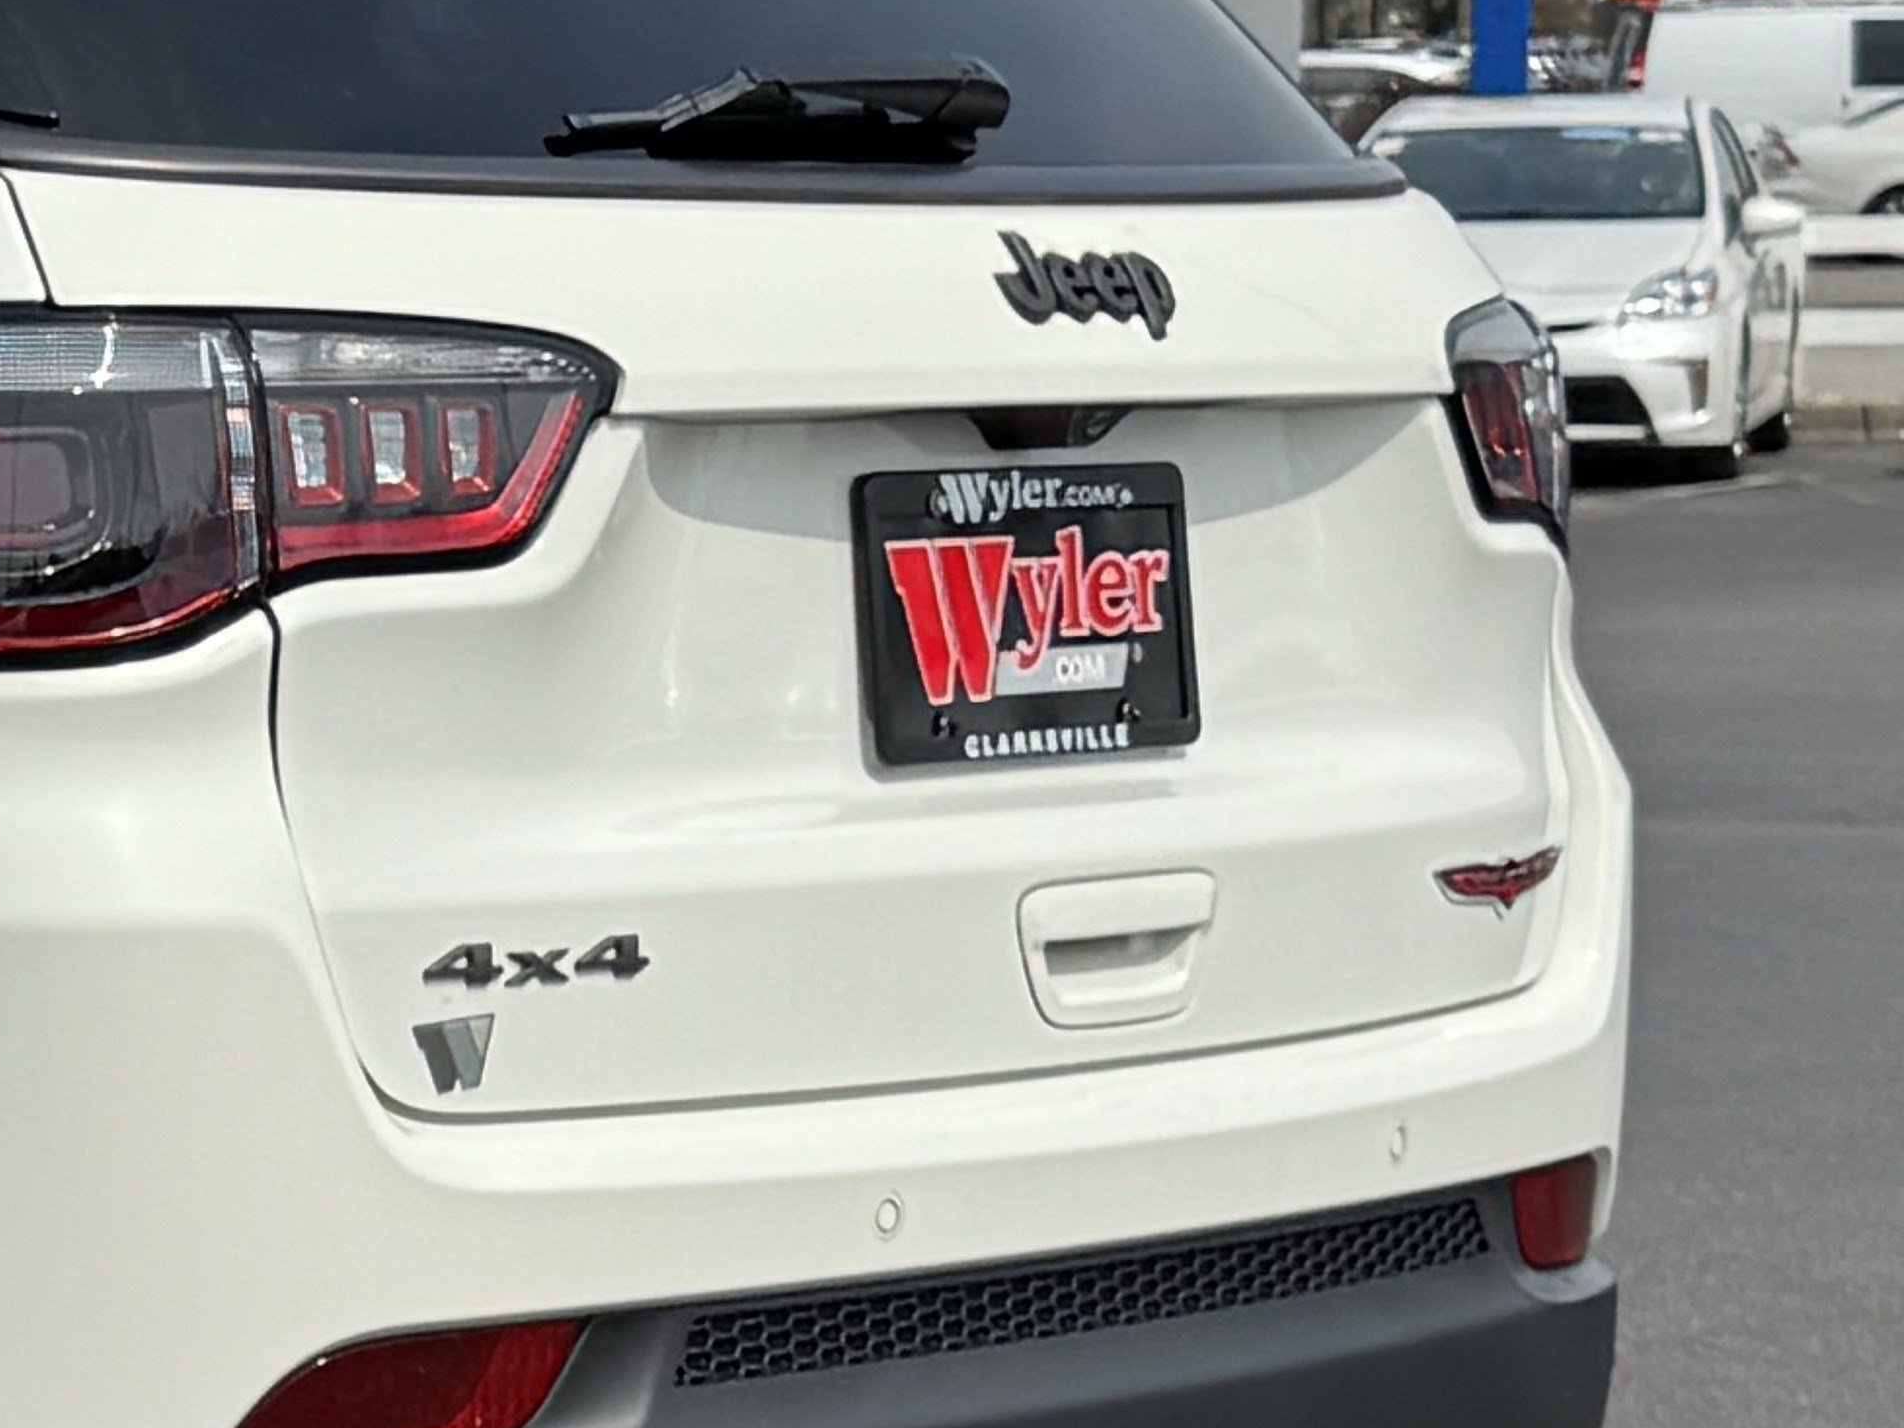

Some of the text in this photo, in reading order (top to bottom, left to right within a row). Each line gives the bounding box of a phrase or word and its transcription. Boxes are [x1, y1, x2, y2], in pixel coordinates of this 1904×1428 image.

[993, 229, 1176, 342] Jeep
[884, 524, 1170, 707] Wyler
[963, 722, 1130, 759] CLARKSVILLE
